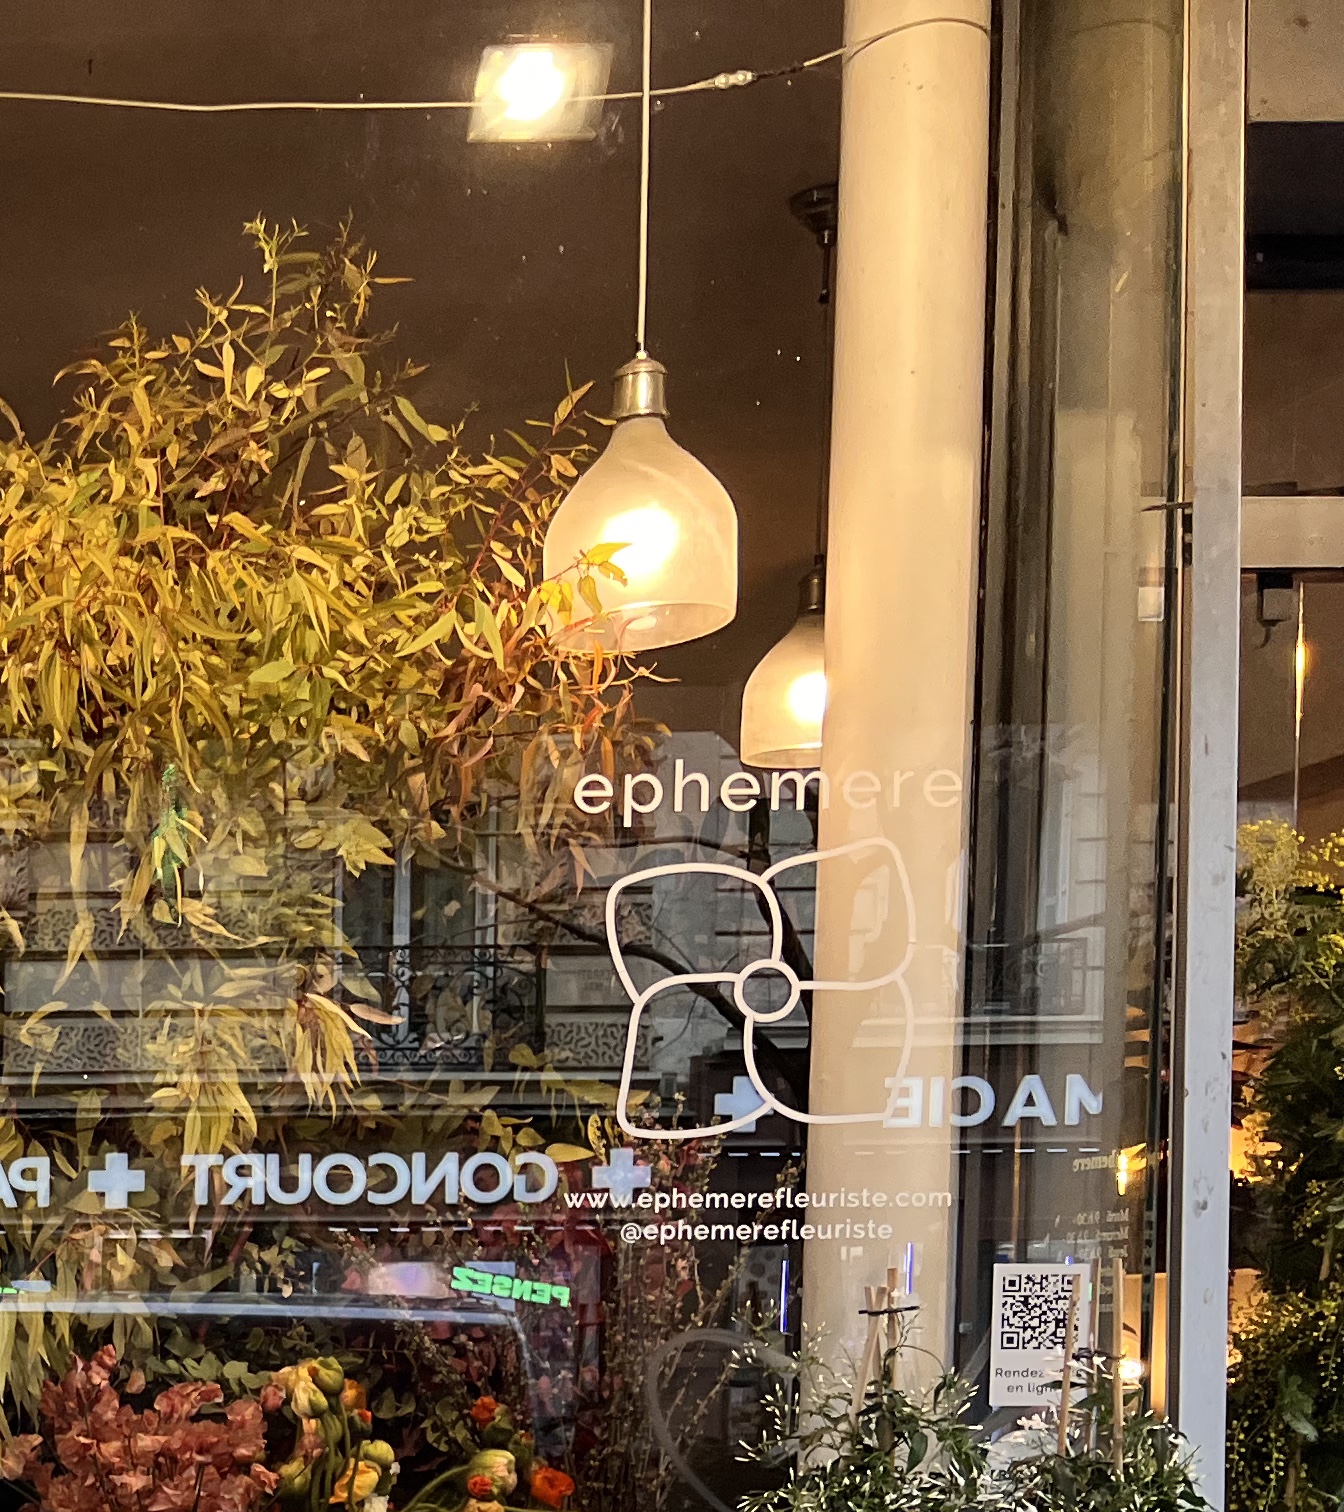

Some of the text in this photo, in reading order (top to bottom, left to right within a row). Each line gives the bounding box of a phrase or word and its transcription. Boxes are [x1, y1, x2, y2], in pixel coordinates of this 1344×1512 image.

[573, 758, 963, 828] ephemere
[564, 1186, 952, 1212] www.ephemerefleuriste.com
[620, 1217, 894, 1245] @ephemerefleuriste
[1007, 1382, 1056, 1396] en lign
